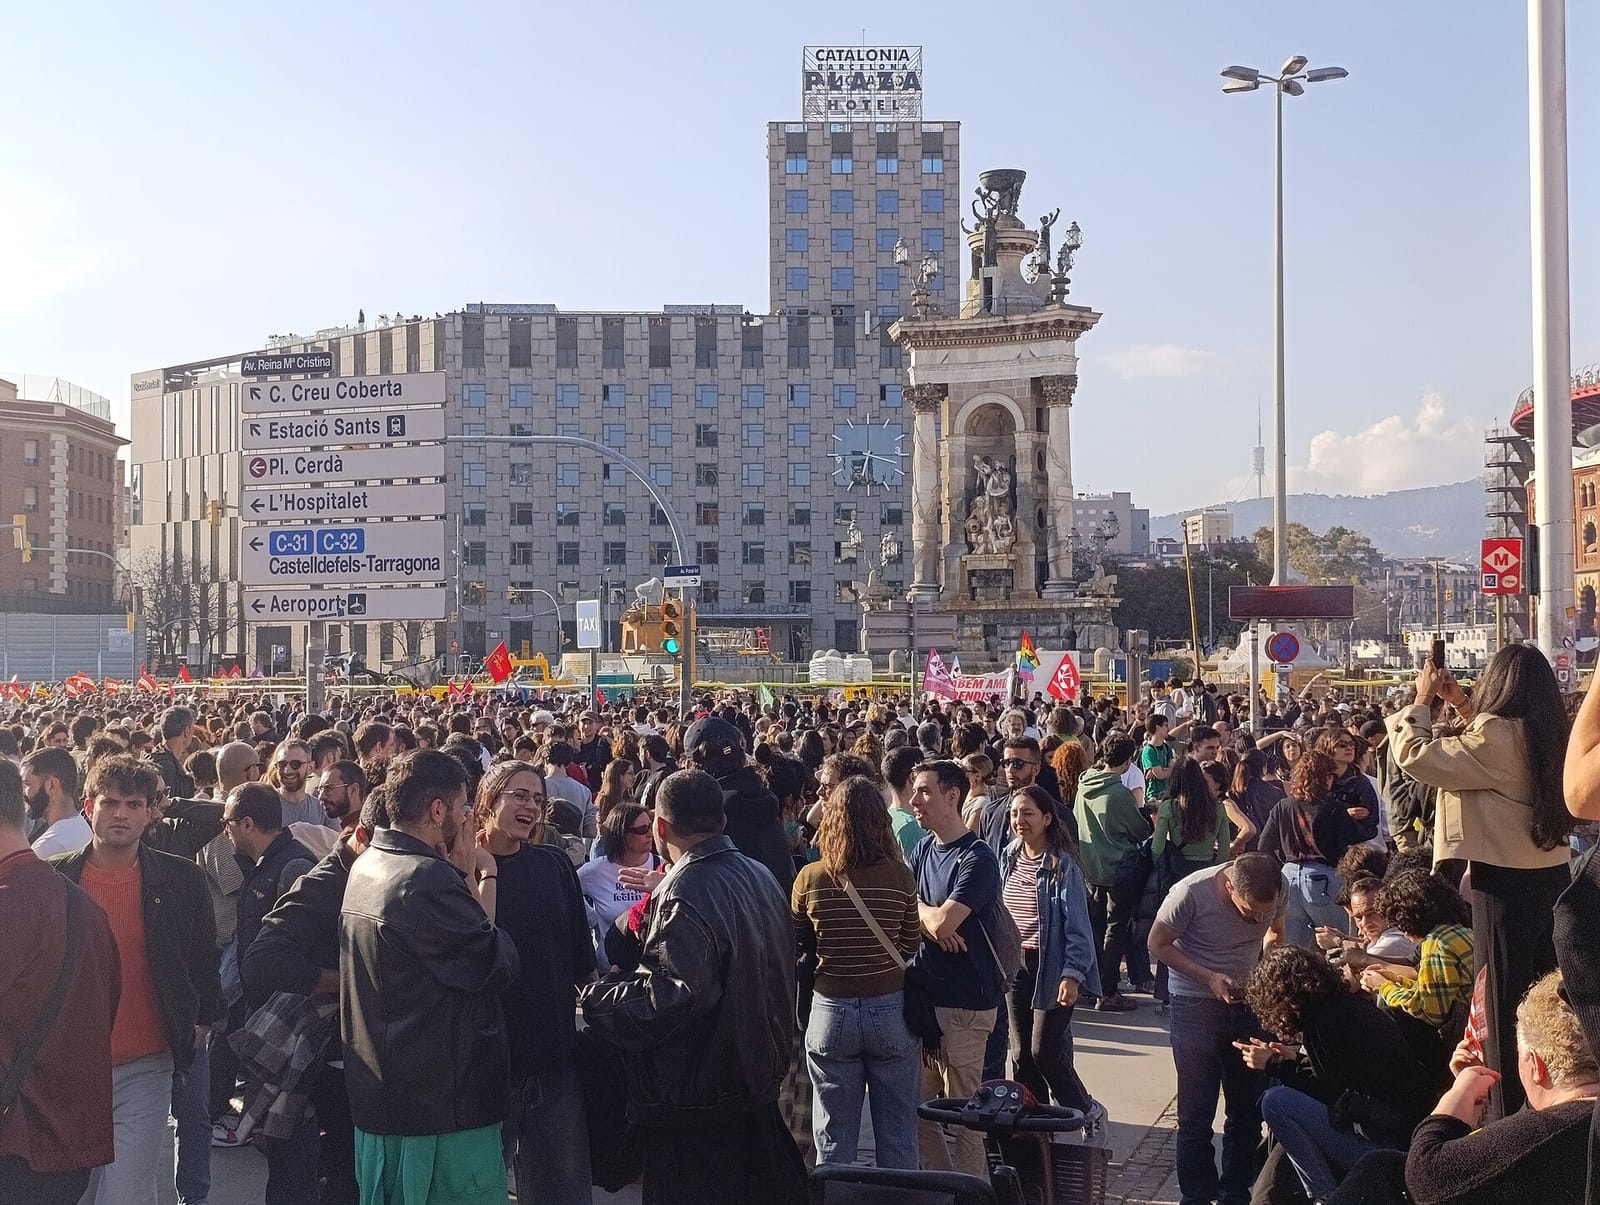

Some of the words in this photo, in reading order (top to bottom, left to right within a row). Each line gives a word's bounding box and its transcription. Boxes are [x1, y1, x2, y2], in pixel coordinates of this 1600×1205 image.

[815, 49, 909, 61] CATALONIA
[805, 71, 921, 90] PLAZA
[828, 99, 899, 111] HOTEL
[243, 360, 257, 371] Av.
[258, 359, 282, 370] Reina
[296, 355, 331, 368] Cristina
[269, 385, 286, 403] C.
[292, 383, 330, 402] Creu
[336, 381, 402, 400] Coberta
[269, 419, 329, 440] Estació
[334, 417, 381, 437] Sants
[269, 457, 289, 476] Pl.
[295, 454, 343, 474] Cerdà
[269, 491, 368, 514] L'Hospitalet
[276, 534, 308, 552] C-31
[323, 532, 358, 550] C-32
[269, 554, 441, 576] Castelldefels-Tarragona
[1494, 553, 1508, 566] M
[270, 594, 341, 616] Aeroport
[578, 617, 599, 632] TAXI
